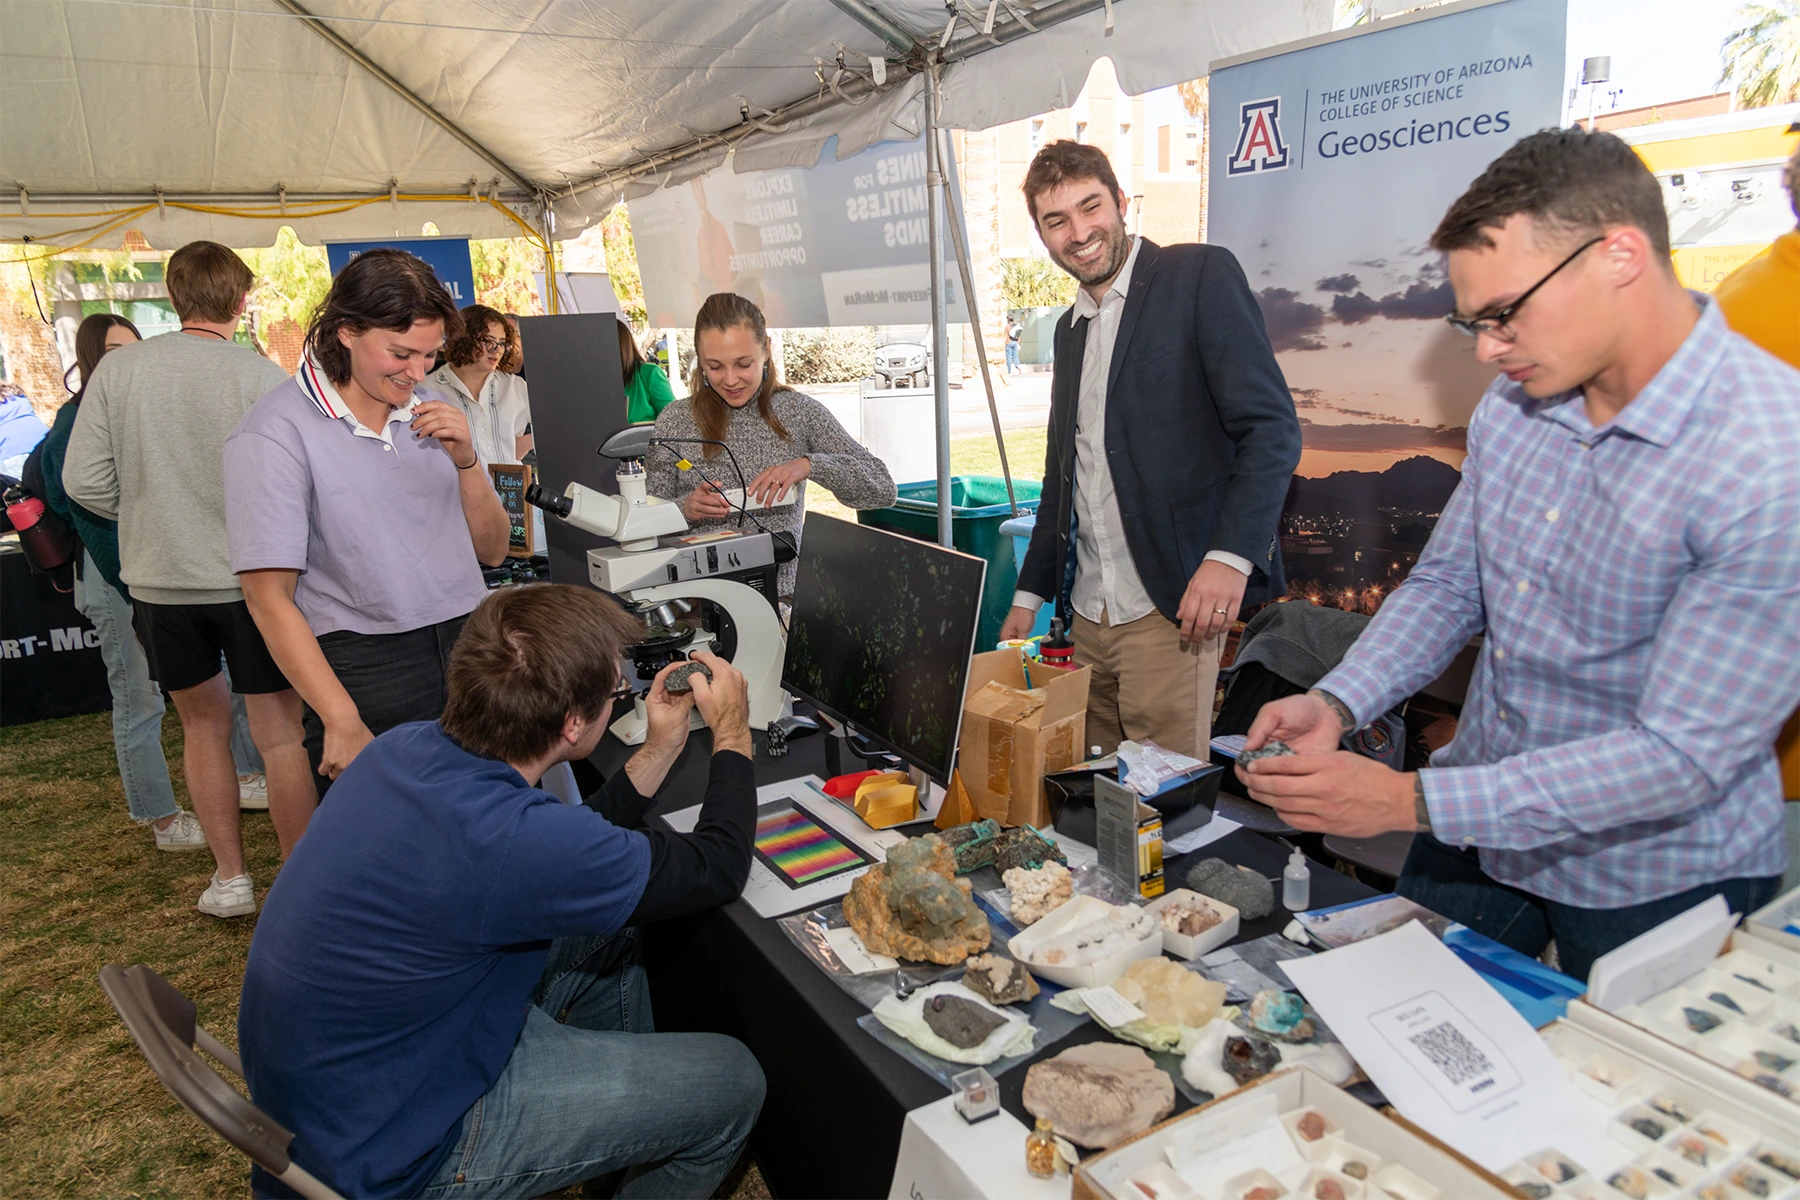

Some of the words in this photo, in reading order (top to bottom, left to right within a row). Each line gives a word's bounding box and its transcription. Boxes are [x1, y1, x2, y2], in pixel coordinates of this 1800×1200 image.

[1319, 100, 1377, 122] COLLEGE
[1381, 96, 1400, 112] OF
[1403, 84, 1464, 108] SCIENCE
[1321, 89, 1345, 106] THE
[1349, 73, 1431, 101] UNIVERSITY
[1434, 68, 1455, 85] OF
[1458, 54, 1533, 80] ARIZONA
[1226, 95, 1290, 178] A
[1317, 110, 1510, 159] Geosciences
[500, 475, 523, 487] Follow
